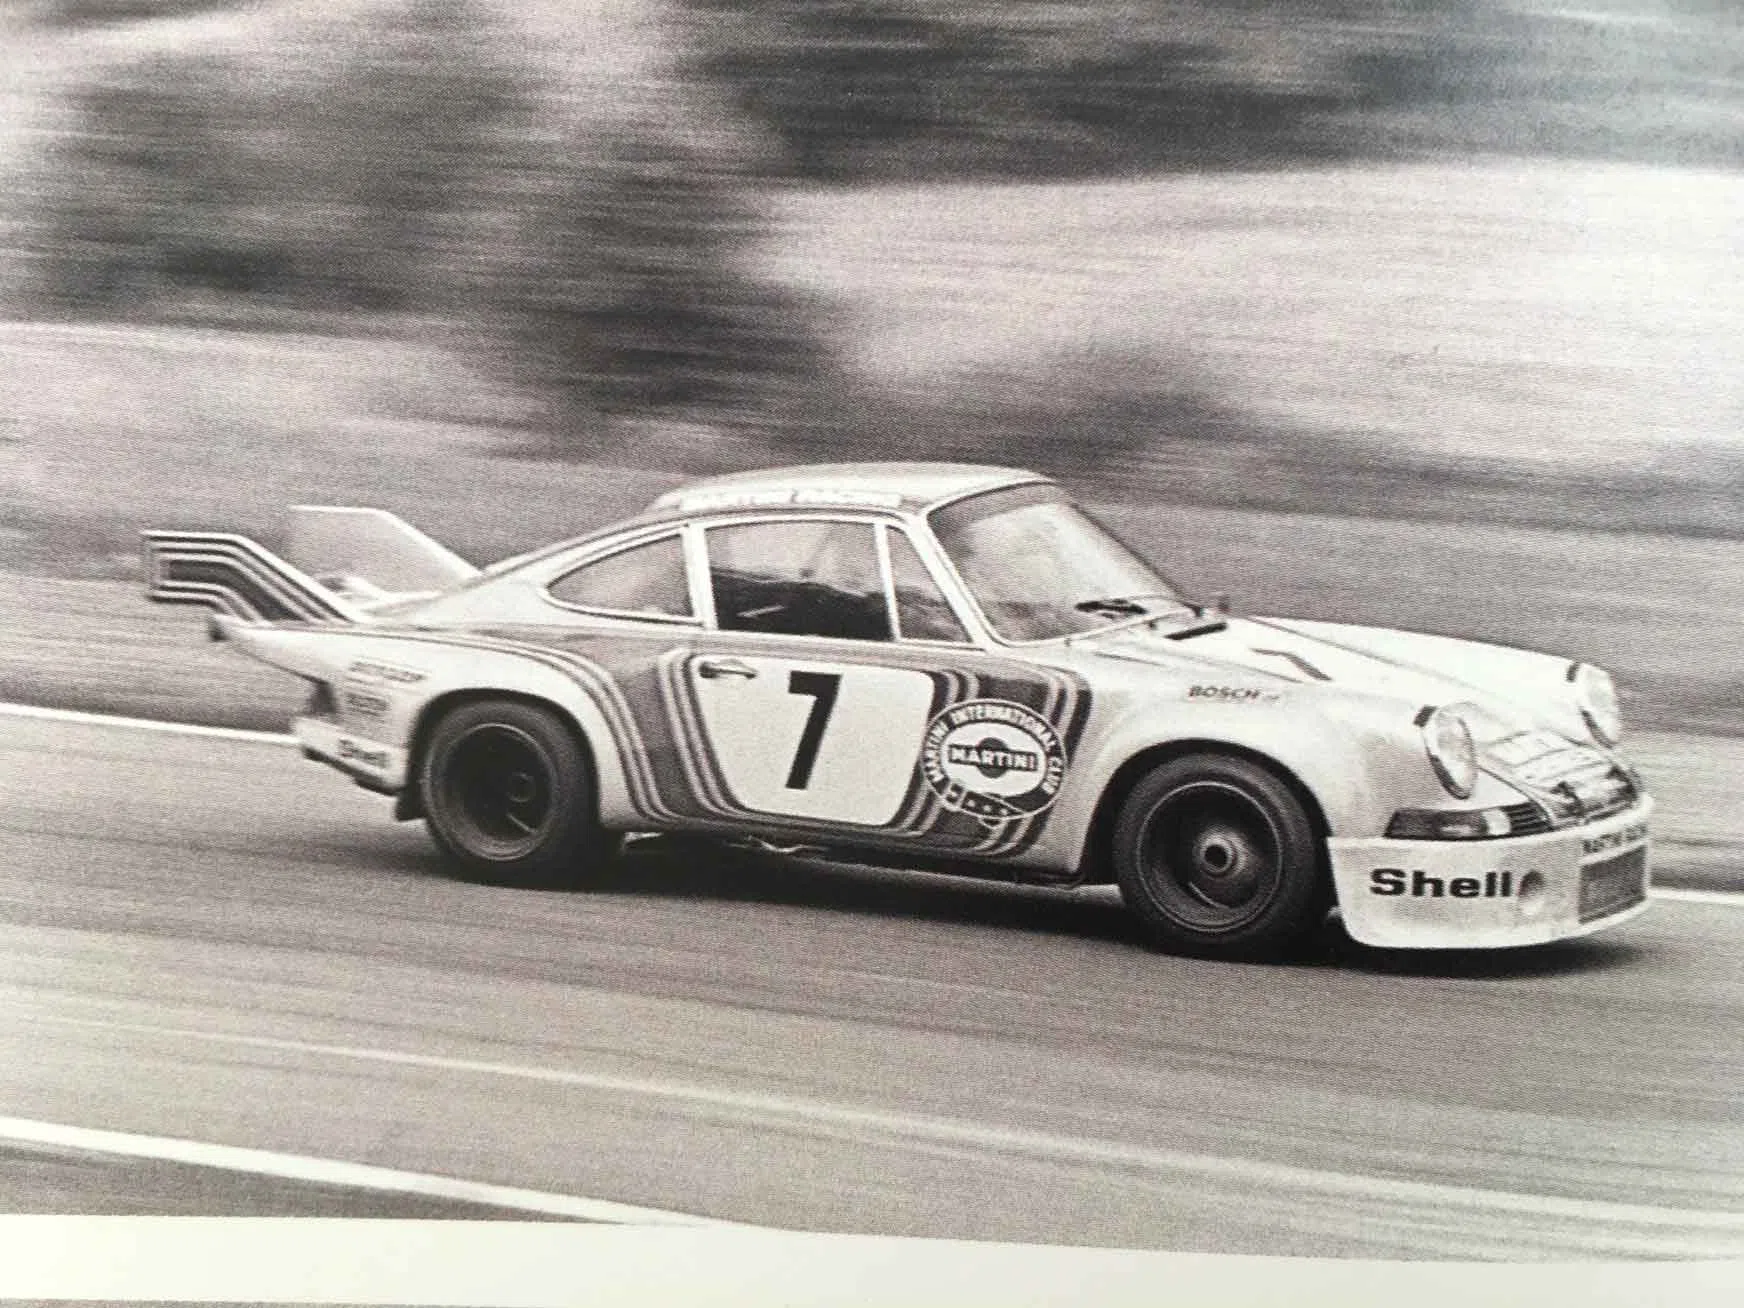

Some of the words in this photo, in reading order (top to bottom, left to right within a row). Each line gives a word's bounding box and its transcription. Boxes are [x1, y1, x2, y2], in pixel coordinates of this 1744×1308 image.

[1188, 685, 1262, 700] BOSCH
[786, 670, 842, 790] 7
[951, 747, 1036, 769] MARTINI
[1370, 868, 1512, 898] Shell
